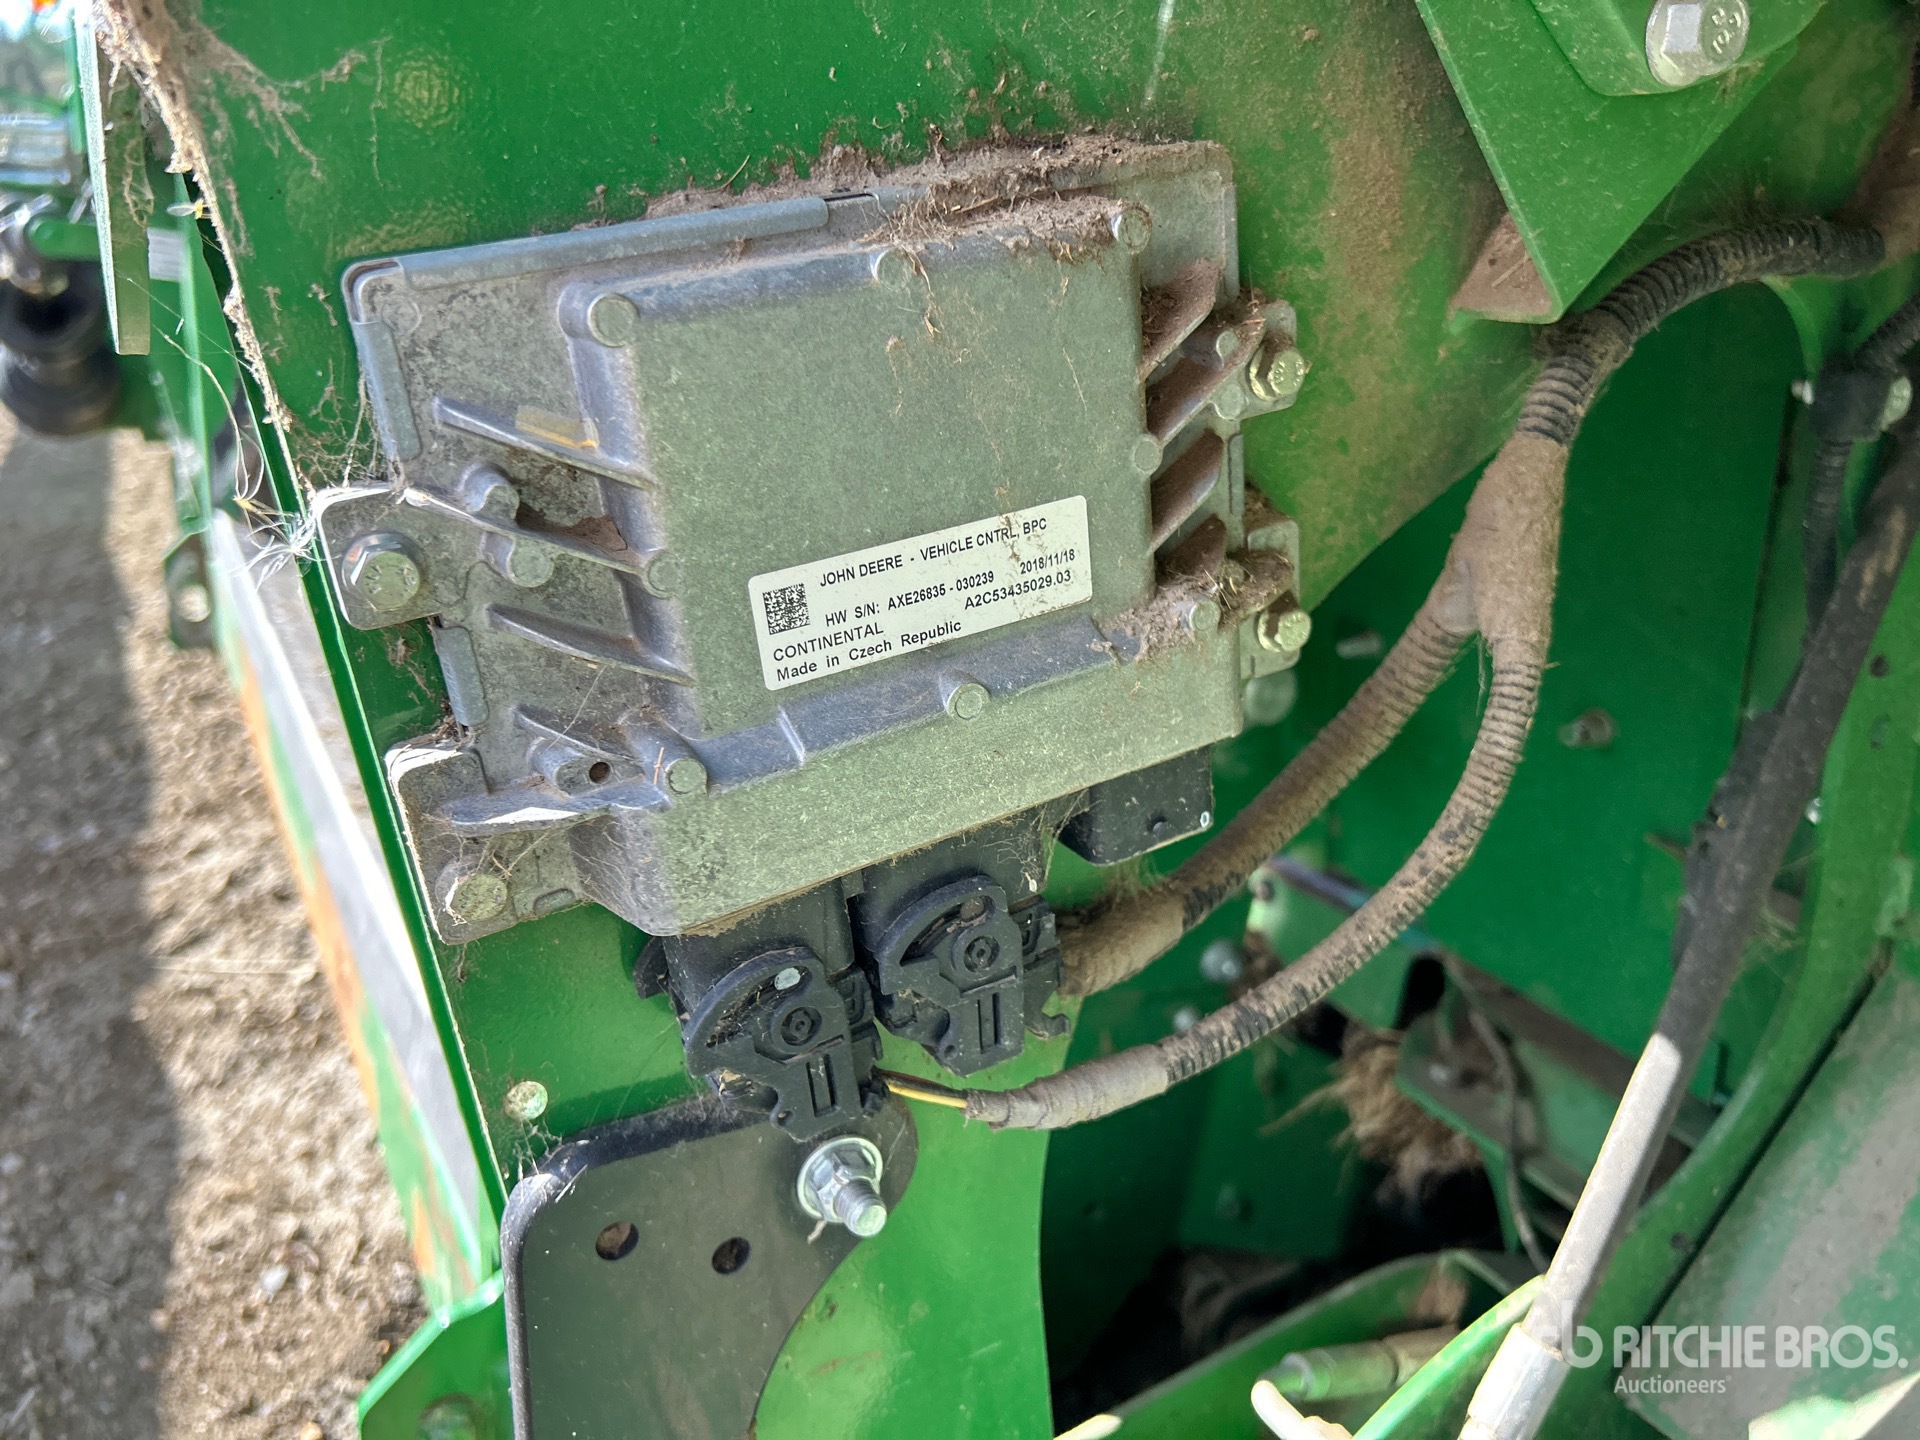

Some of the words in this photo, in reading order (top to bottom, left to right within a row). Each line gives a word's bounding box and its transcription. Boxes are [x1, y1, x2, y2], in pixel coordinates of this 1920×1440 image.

[820, 567, 855, 587] JOHN
[859, 554, 903, 577] DEERE
[920, 536, 973, 561] VEHICLE
[1023, 517, 1047, 535] BPC
[825, 609, 847, 627] HW
[854, 602, 880, 619] S/N:
[888, 583, 946, 611] AXE26835
[956, 570, 994, 592] 030239
[1020, 548, 1075, 575] 2018/11/18
[965, 570, 1071, 610] A2C53435029.03
[773, 622, 884, 662] CONTINENTAL
[777, 662, 818, 681] Made
[826, 655, 840, 668] in
[848, 639, 892, 661] Czech
[901, 620, 962, 647] Republic
